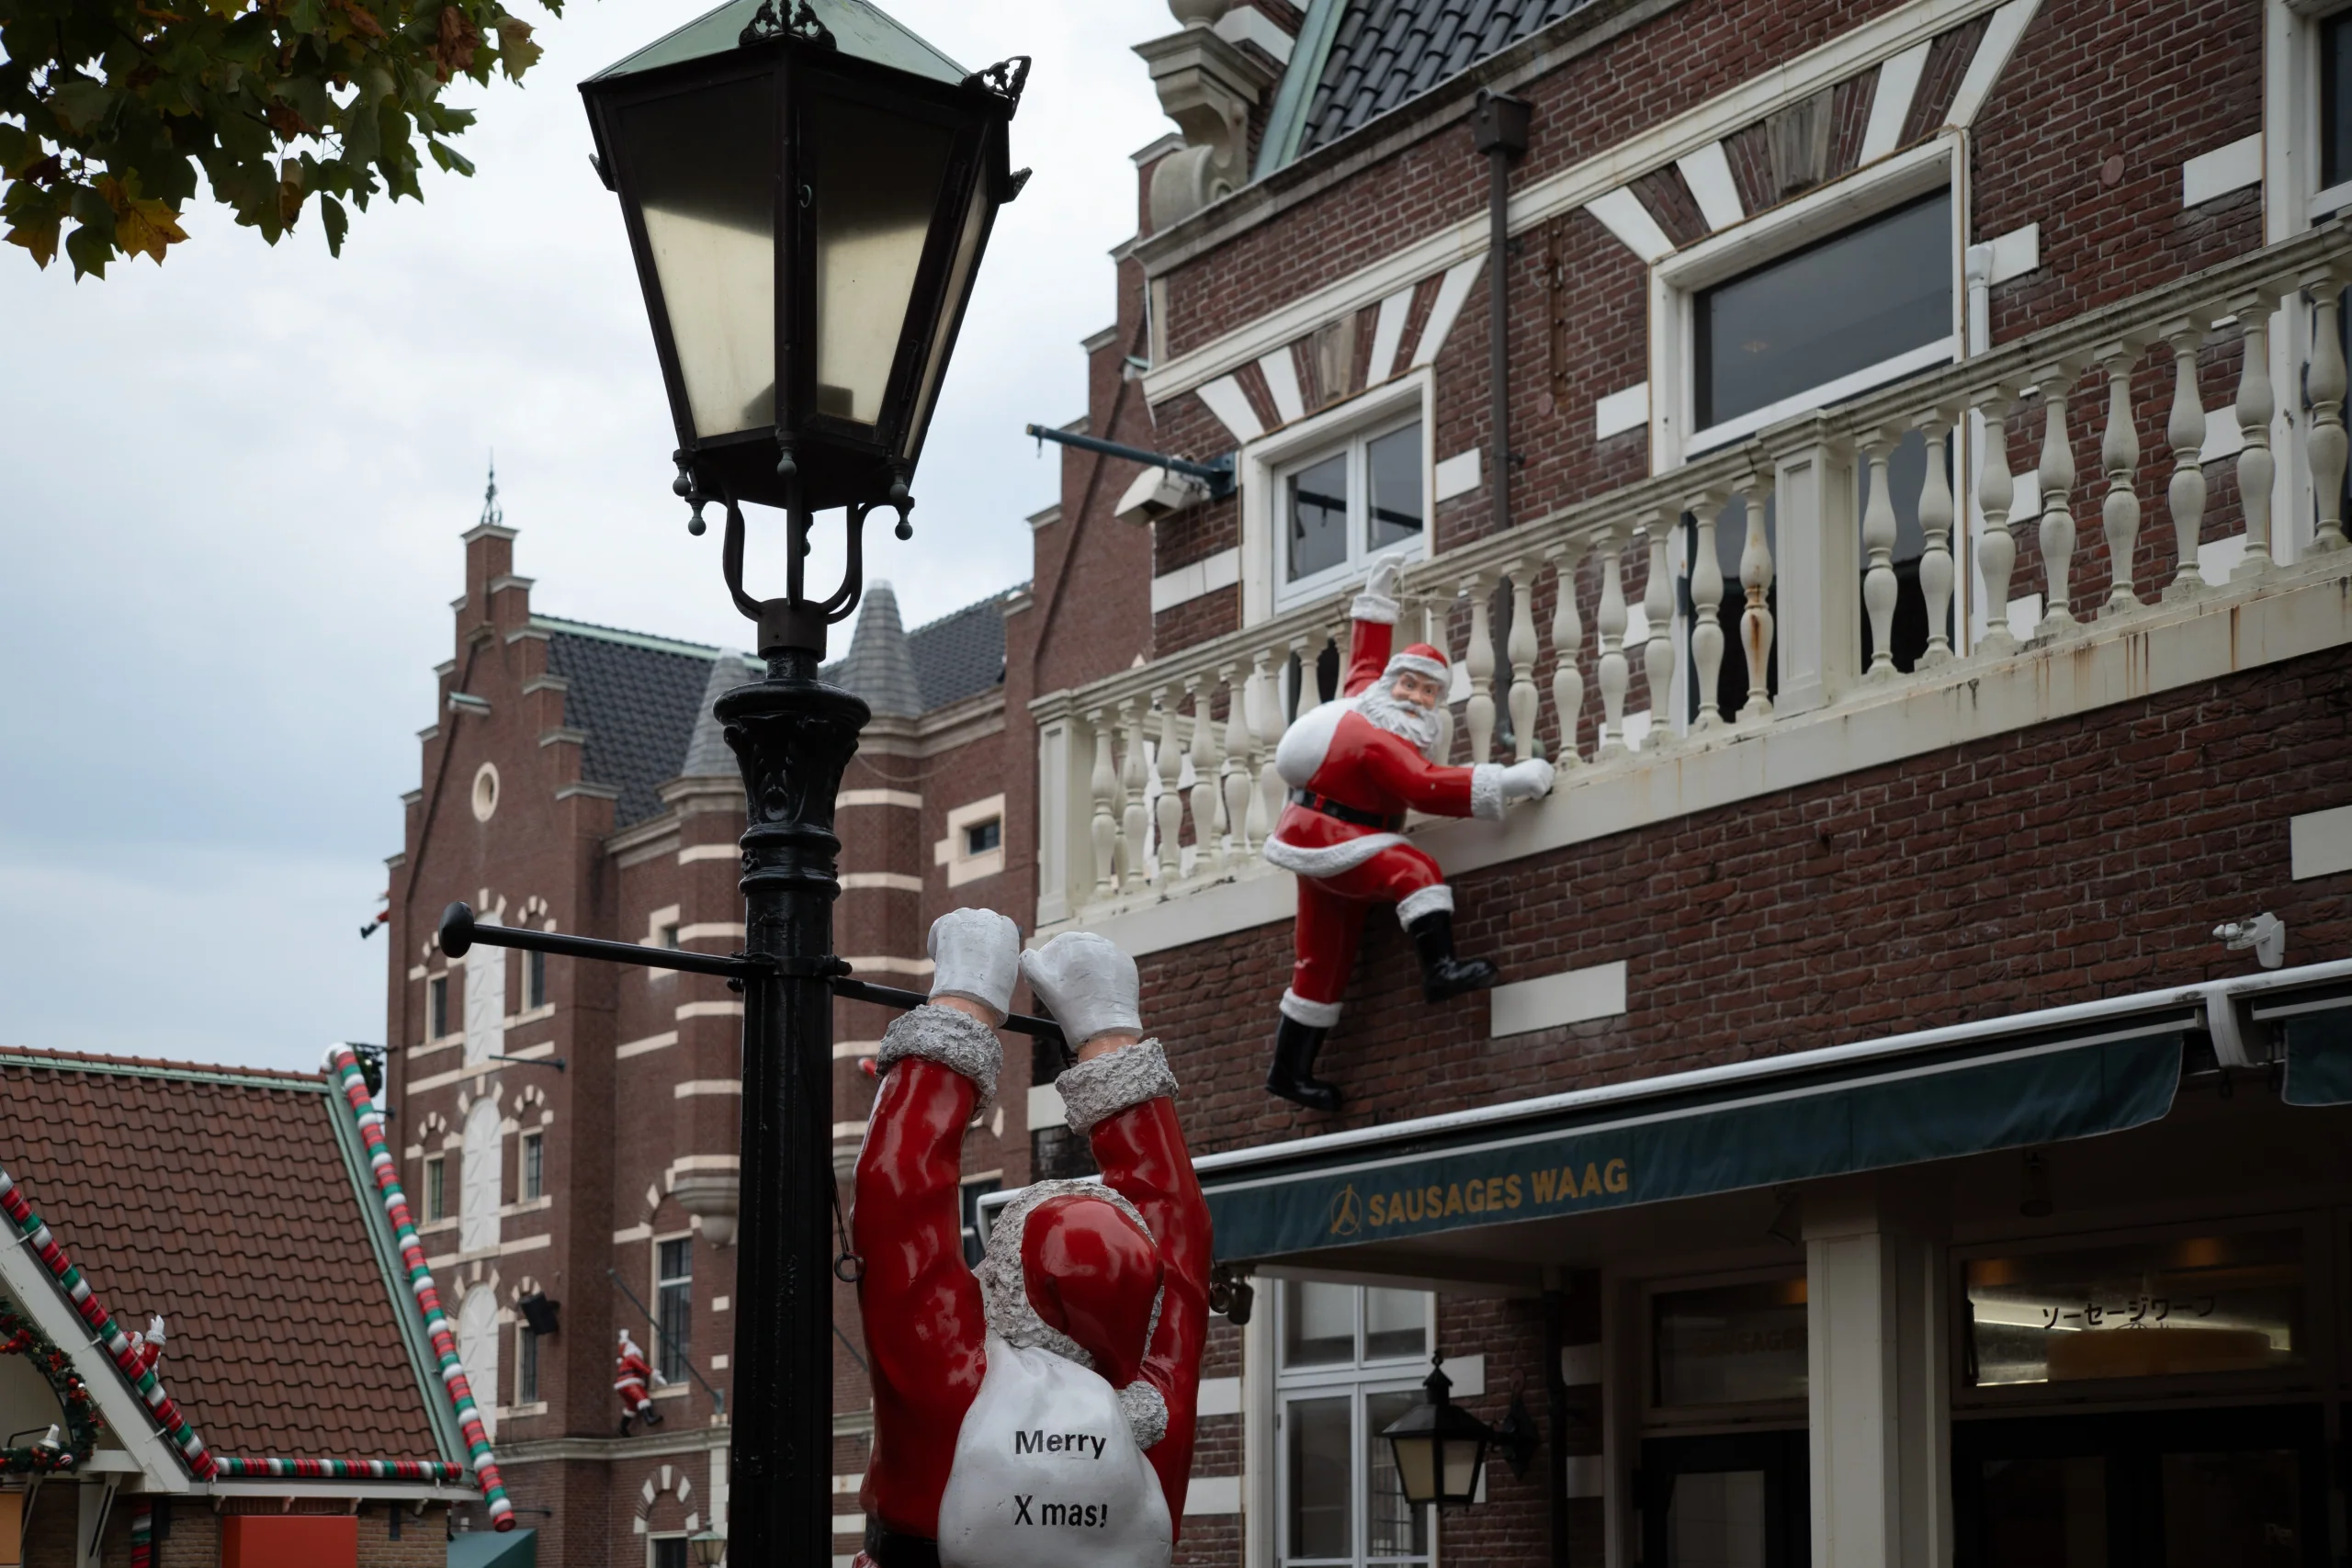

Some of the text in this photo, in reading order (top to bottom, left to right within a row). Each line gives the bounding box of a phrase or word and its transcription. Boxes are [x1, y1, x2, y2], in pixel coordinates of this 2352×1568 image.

[1368, 1158, 1629, 1225] SAUSAGES WAAG
[2042, 1294, 2216, 1329] ソーセージワーフ
[1015, 1429, 1107, 1460] Merry
